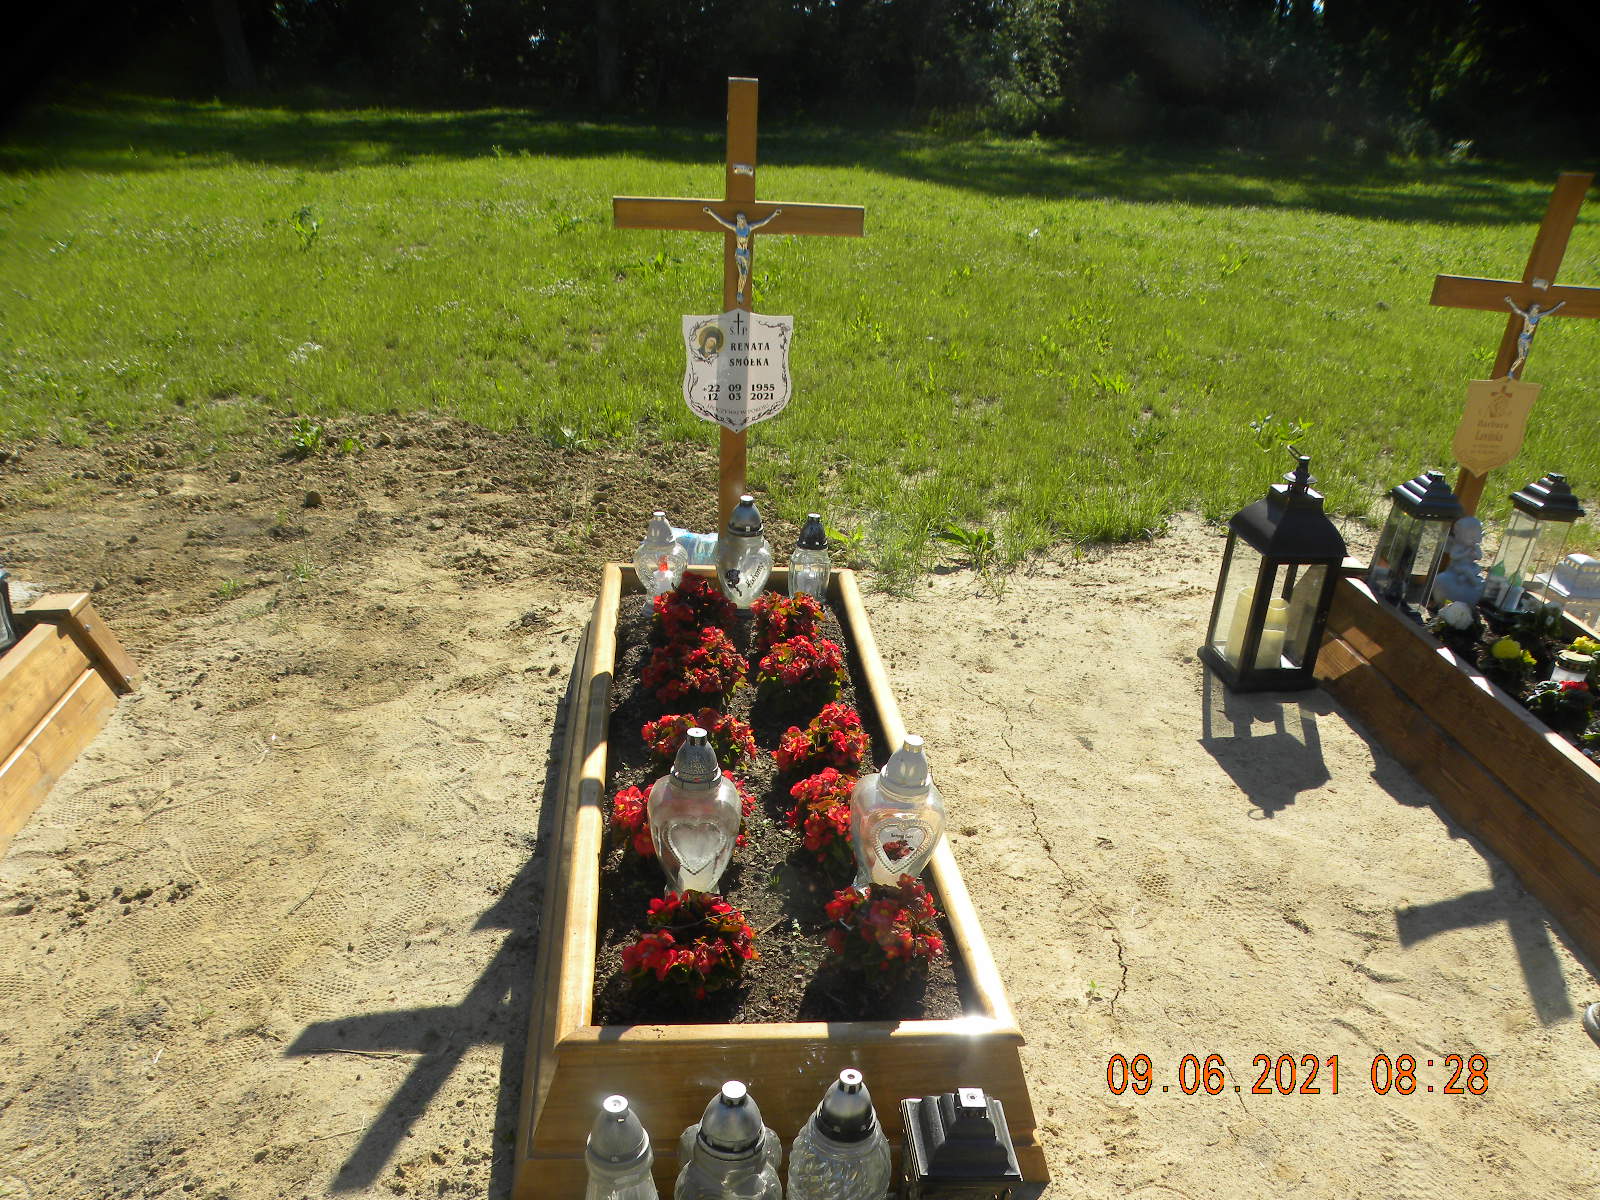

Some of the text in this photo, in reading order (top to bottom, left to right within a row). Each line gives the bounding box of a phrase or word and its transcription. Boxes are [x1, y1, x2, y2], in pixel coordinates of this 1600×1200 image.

[730, 342, 770, 351] RENATA
[729, 356, 769, 367] SMÓŁKA
[728, 383, 742, 392] 09
[751, 383, 775, 392] 1955
[750, 392, 774, 401] 2021
